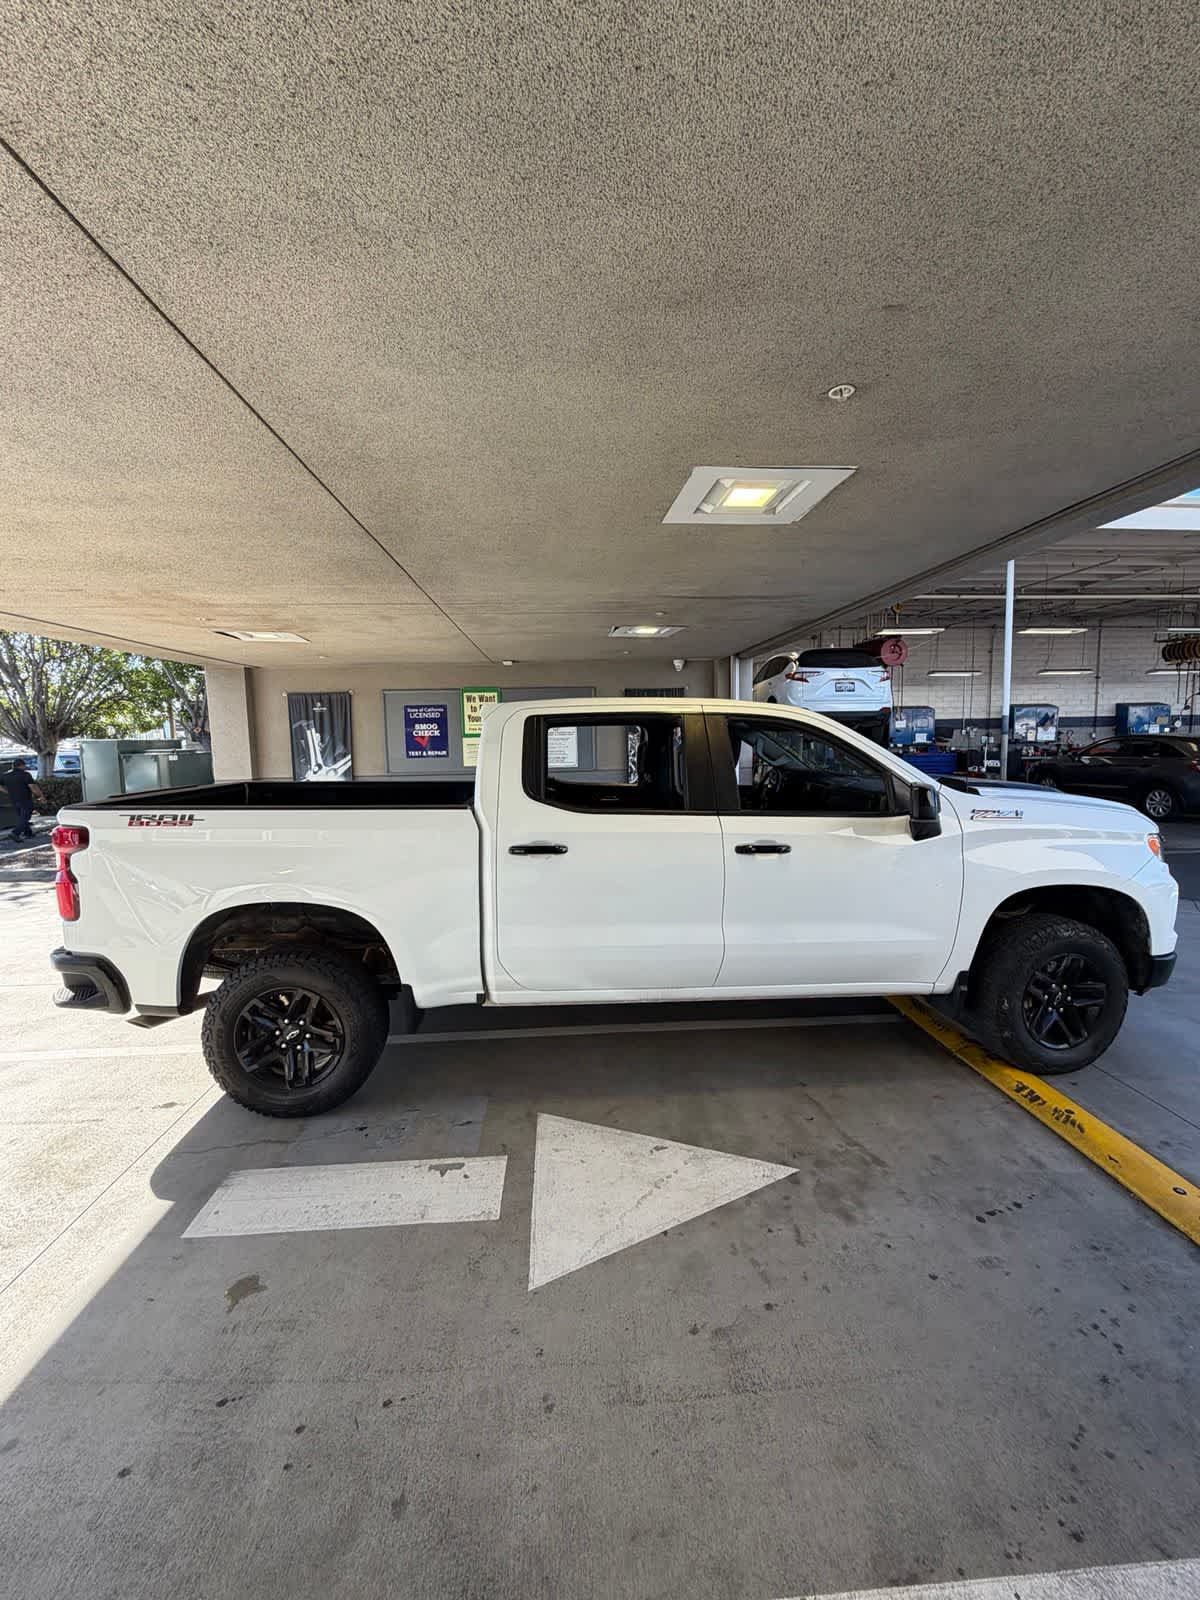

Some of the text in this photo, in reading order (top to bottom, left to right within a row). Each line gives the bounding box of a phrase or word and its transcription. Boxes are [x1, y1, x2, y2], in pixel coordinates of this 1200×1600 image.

[465, 694, 496, 703] We Want
[470, 704, 478, 713] to
